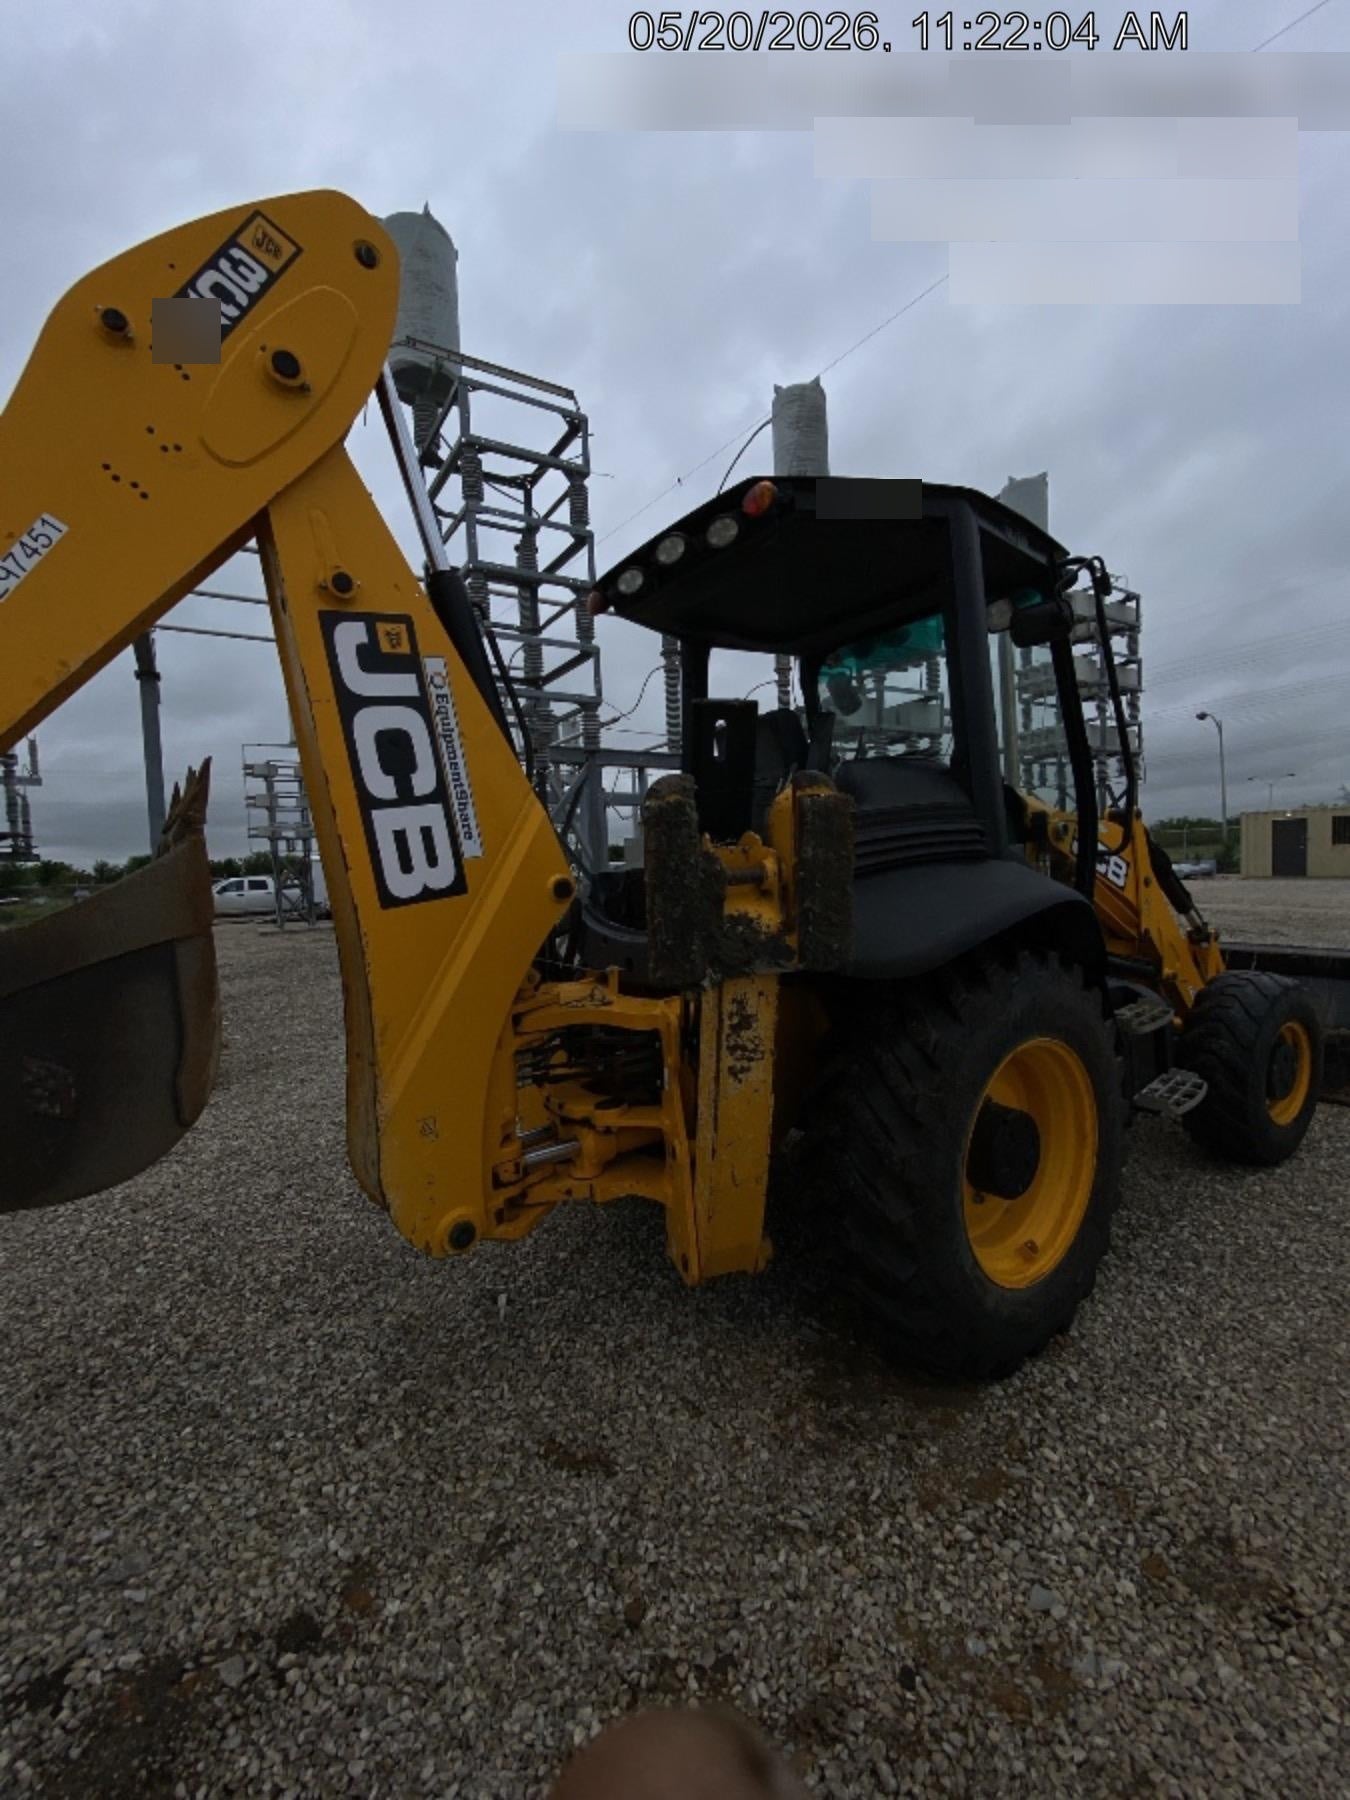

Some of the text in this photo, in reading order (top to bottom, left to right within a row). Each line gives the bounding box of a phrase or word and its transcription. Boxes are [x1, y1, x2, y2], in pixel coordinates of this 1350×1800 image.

[188, 247, 269, 325] 3C
[333, 621, 457, 899] JCB
[434, 694, 473, 841] EquipmentShare
